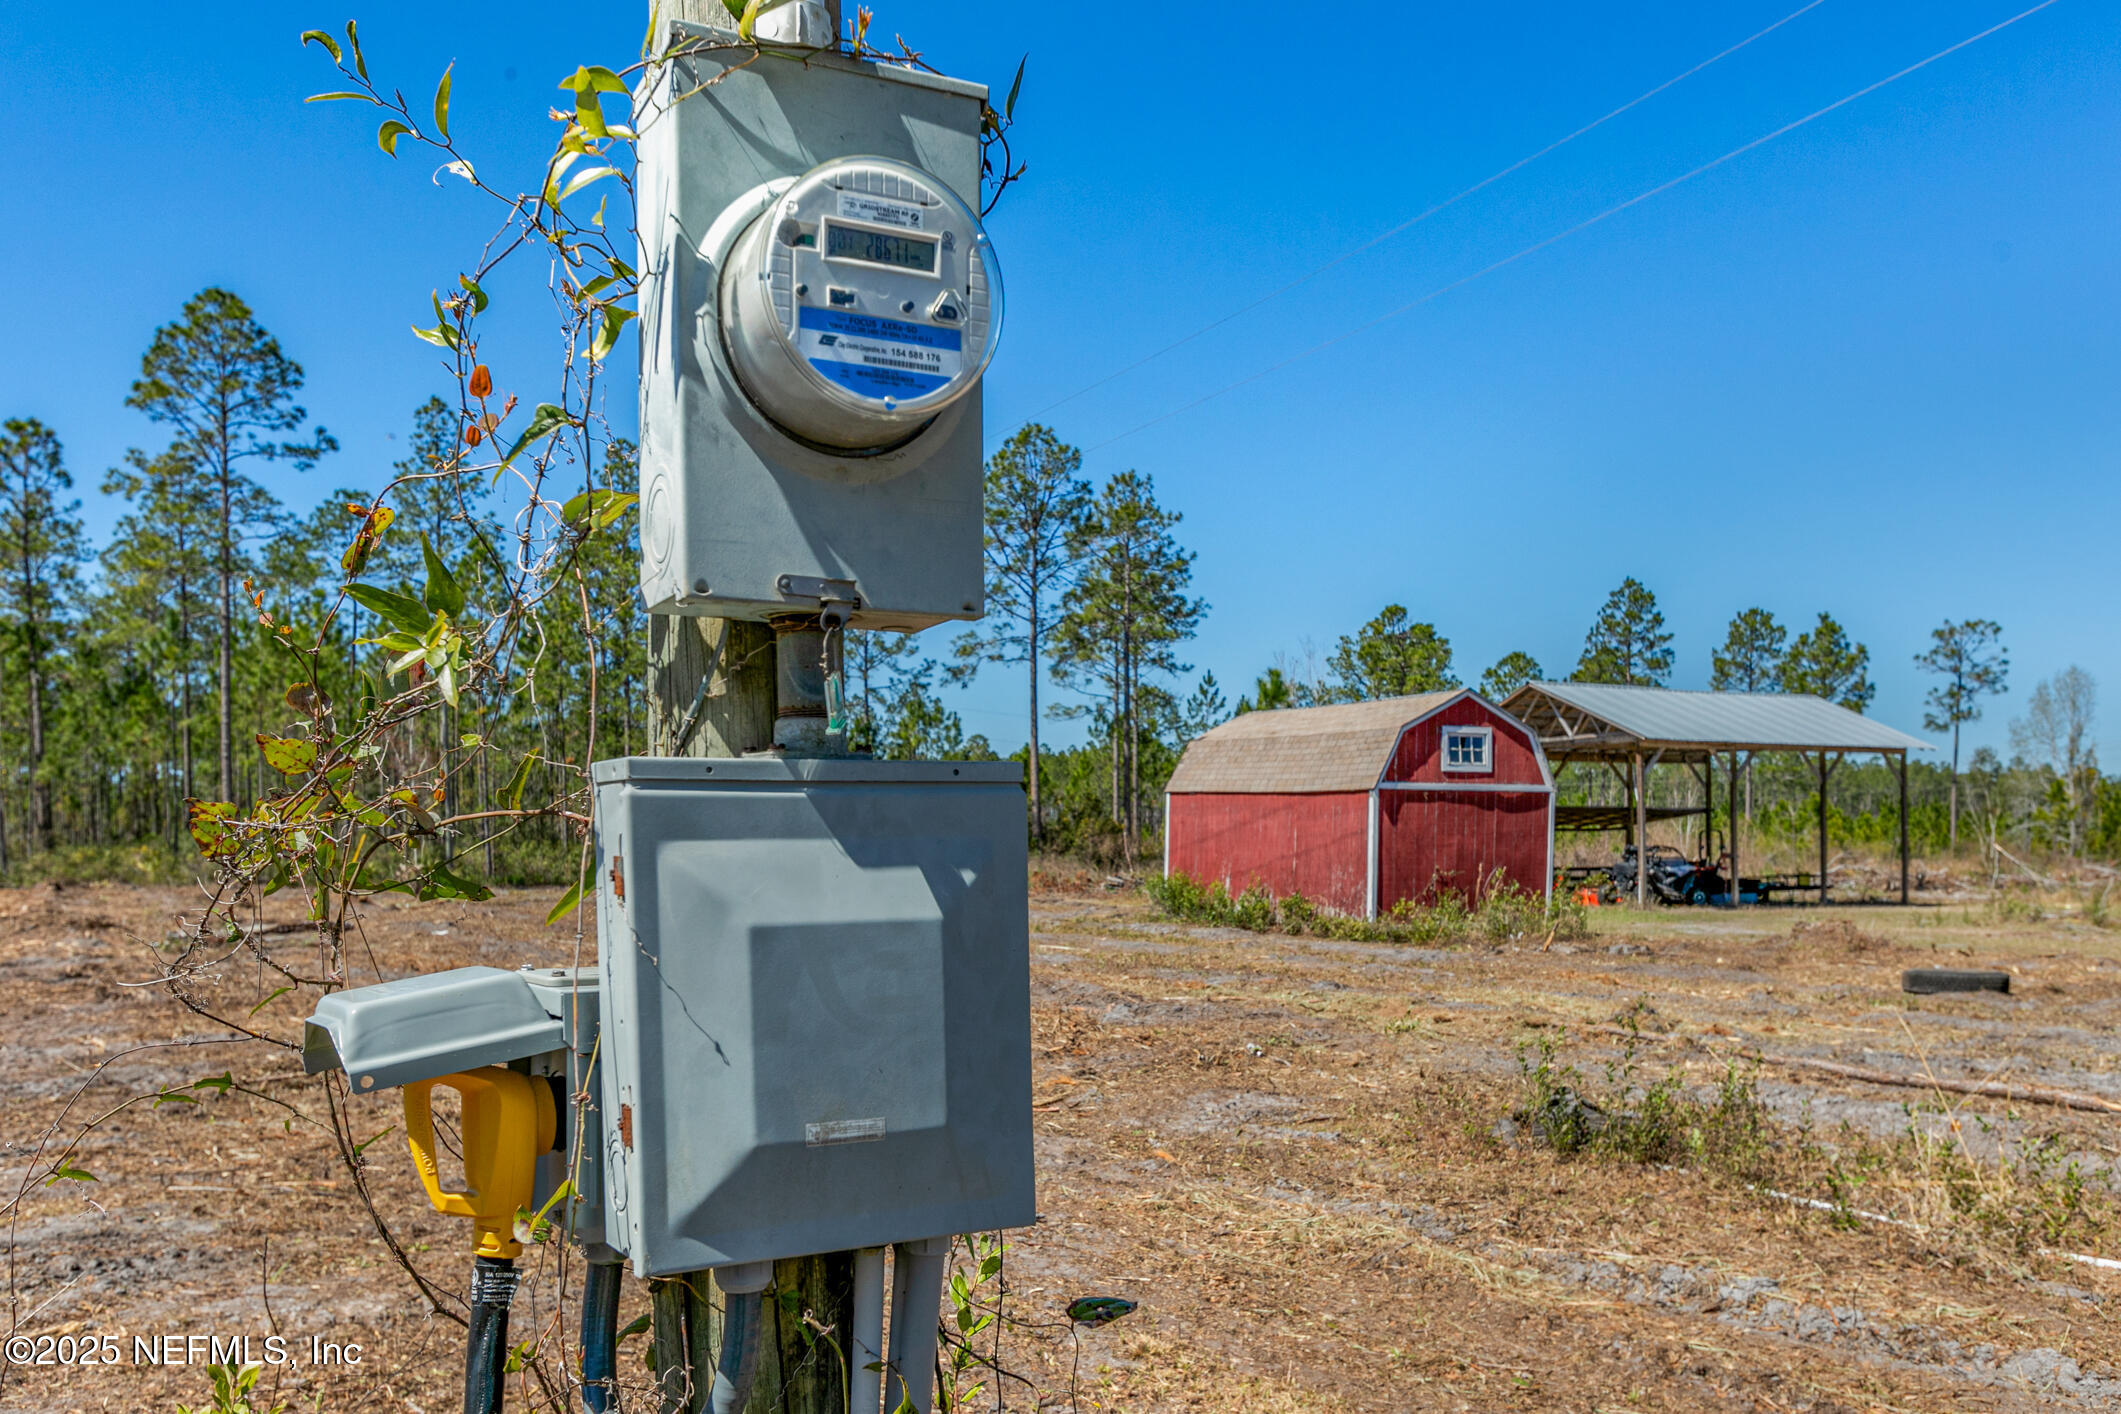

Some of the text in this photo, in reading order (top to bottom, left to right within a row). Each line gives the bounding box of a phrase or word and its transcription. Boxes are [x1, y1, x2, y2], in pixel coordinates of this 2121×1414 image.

[849, 316, 877, 329] FOCUS
[891, 347, 906, 358] 154
[926, 351, 941, 363] 176
